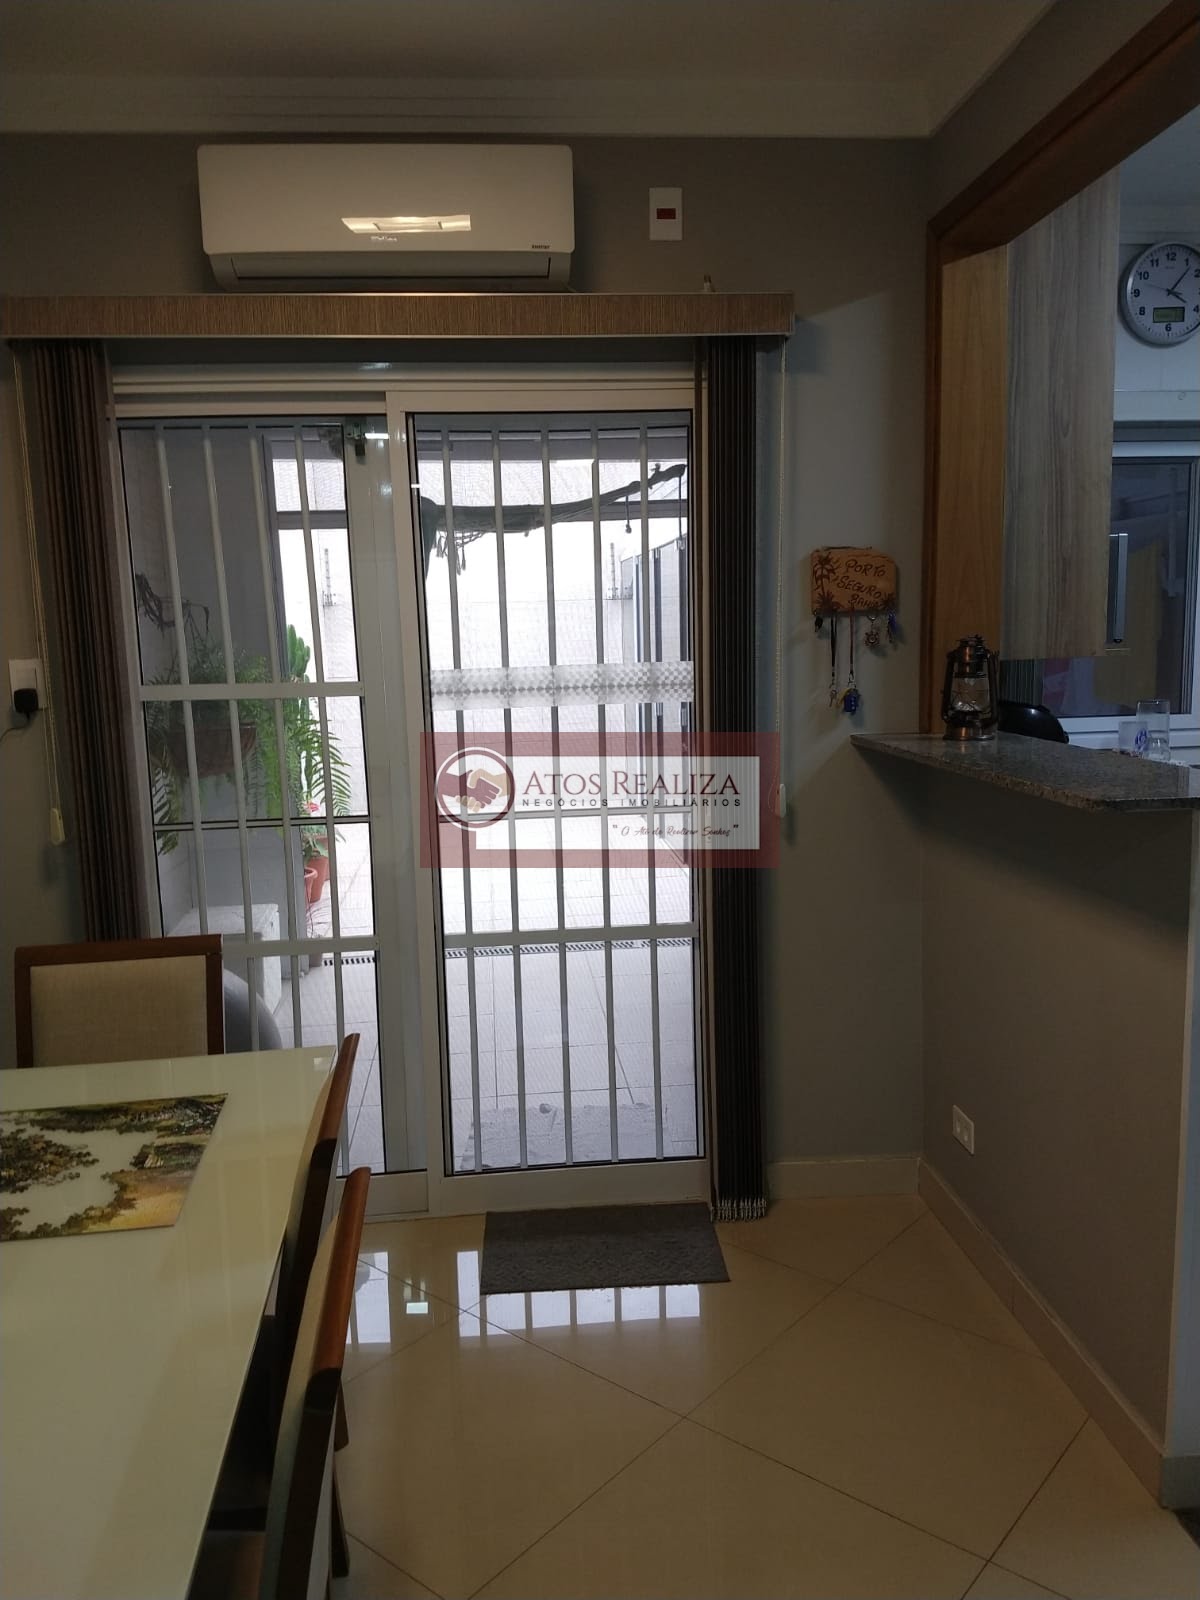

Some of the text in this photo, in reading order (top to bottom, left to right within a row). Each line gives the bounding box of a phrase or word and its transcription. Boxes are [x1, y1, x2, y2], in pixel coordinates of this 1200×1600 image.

[1166, 252, 1177, 261] 12
[1150, 258, 1159, 267] 11
[1184, 258, 1189, 266] 1
[1138, 271, 1149, 280] 10
[1194, 269, 1200, 278] 2
[1133, 288, 1140, 297] 9
[1138, 306, 1146, 315] 8
[1193, 304, 1199, 313] 4
[1165, 323, 1172, 332] 6
[845, 558, 886, 577] PORTO
[837, 575, 882, 599] SEGURO
